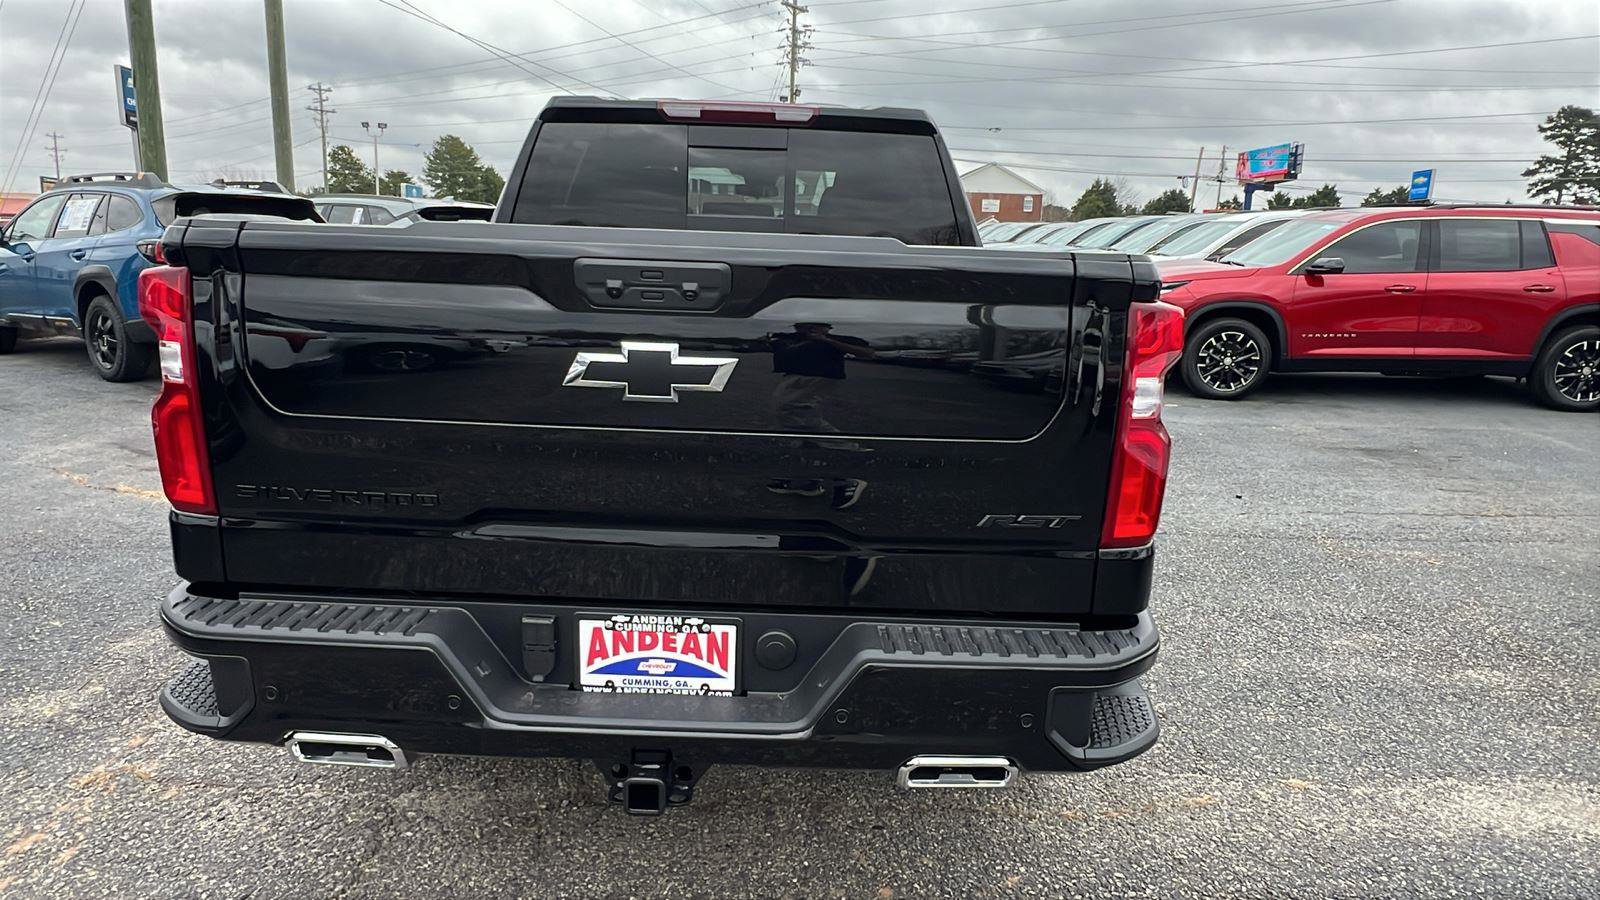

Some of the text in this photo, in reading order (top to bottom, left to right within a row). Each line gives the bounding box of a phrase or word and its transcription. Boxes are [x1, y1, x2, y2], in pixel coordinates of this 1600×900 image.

[235, 484, 440, 507] SILVERADO
[976, 514, 1082, 528] RST
[632, 615, 682, 625] ANDEAN
[615, 623, 698, 633] CUMMING, GA
[587, 627, 729, 672] ANDEAN
[622, 678, 693, 688] CUMMING, GA.
